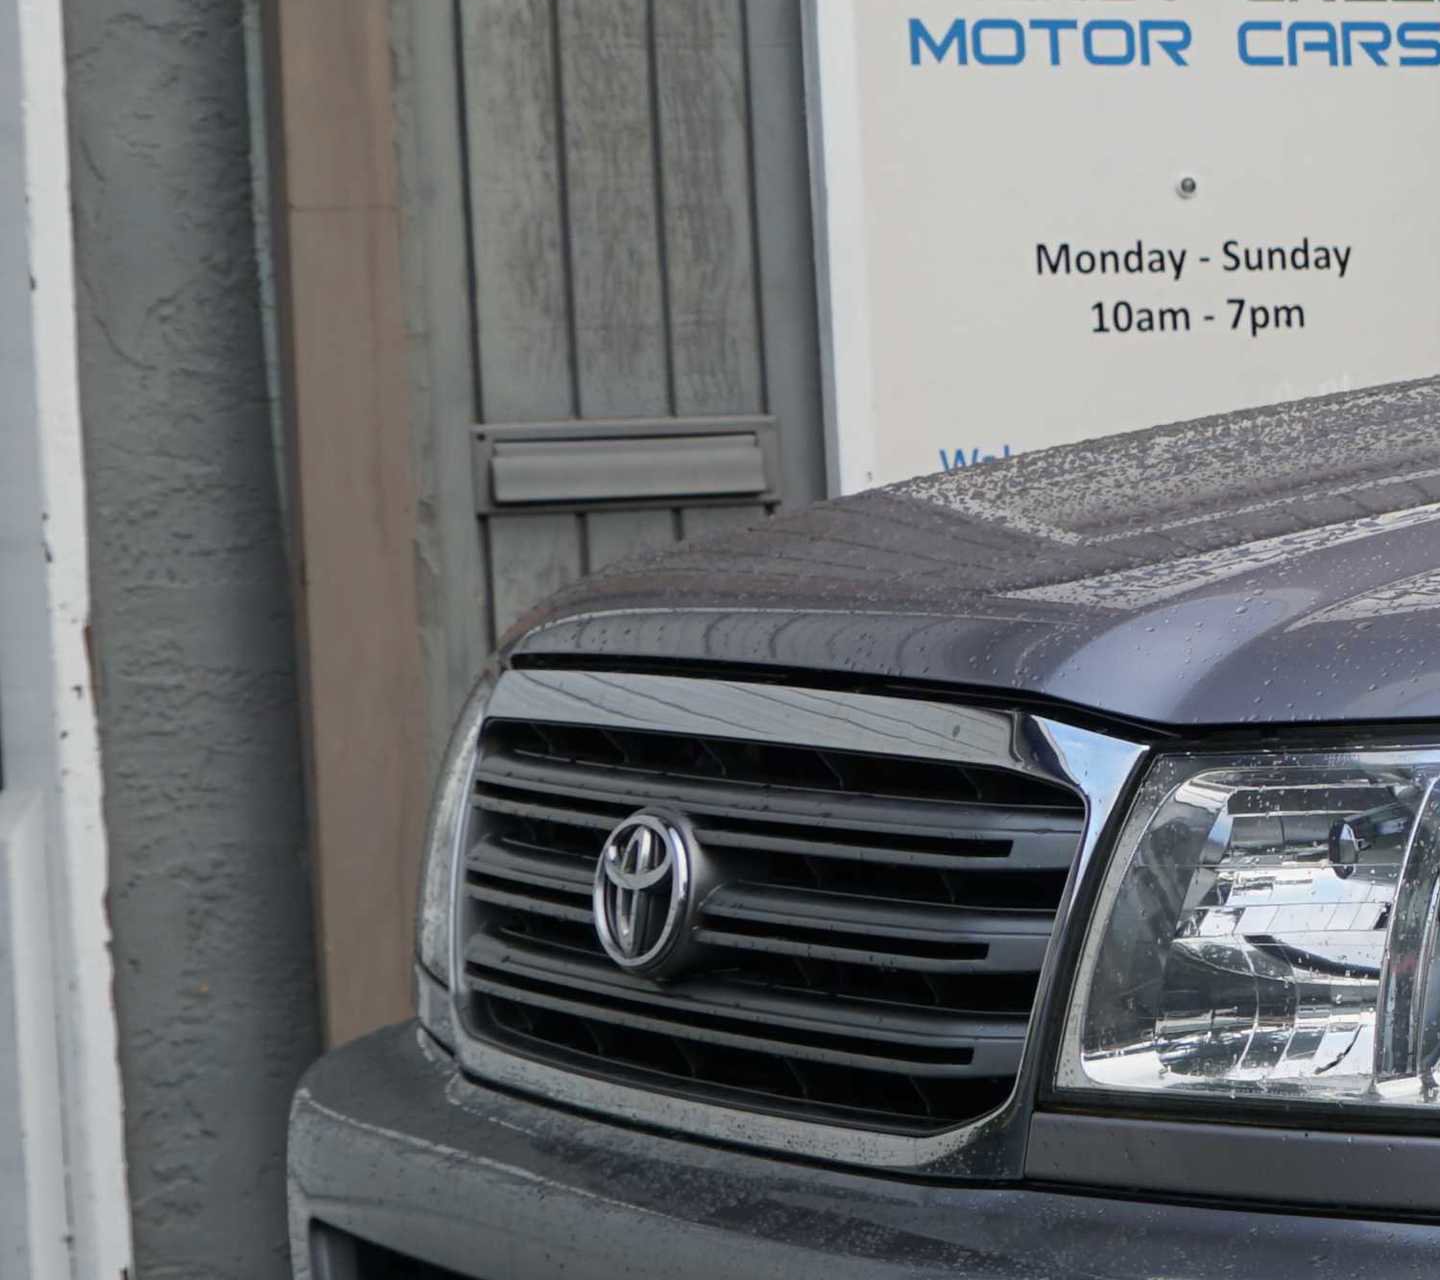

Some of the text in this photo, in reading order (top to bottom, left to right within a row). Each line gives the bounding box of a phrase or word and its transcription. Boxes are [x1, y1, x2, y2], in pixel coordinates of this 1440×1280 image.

[908, 18, 1193, 66] MOTOR
[1035, 239, 1187, 281] Monday
[1221, 236, 1352, 278] Sunday
[1091, 300, 1191, 333] 10am
[1225, 298, 1306, 336] 7pm
